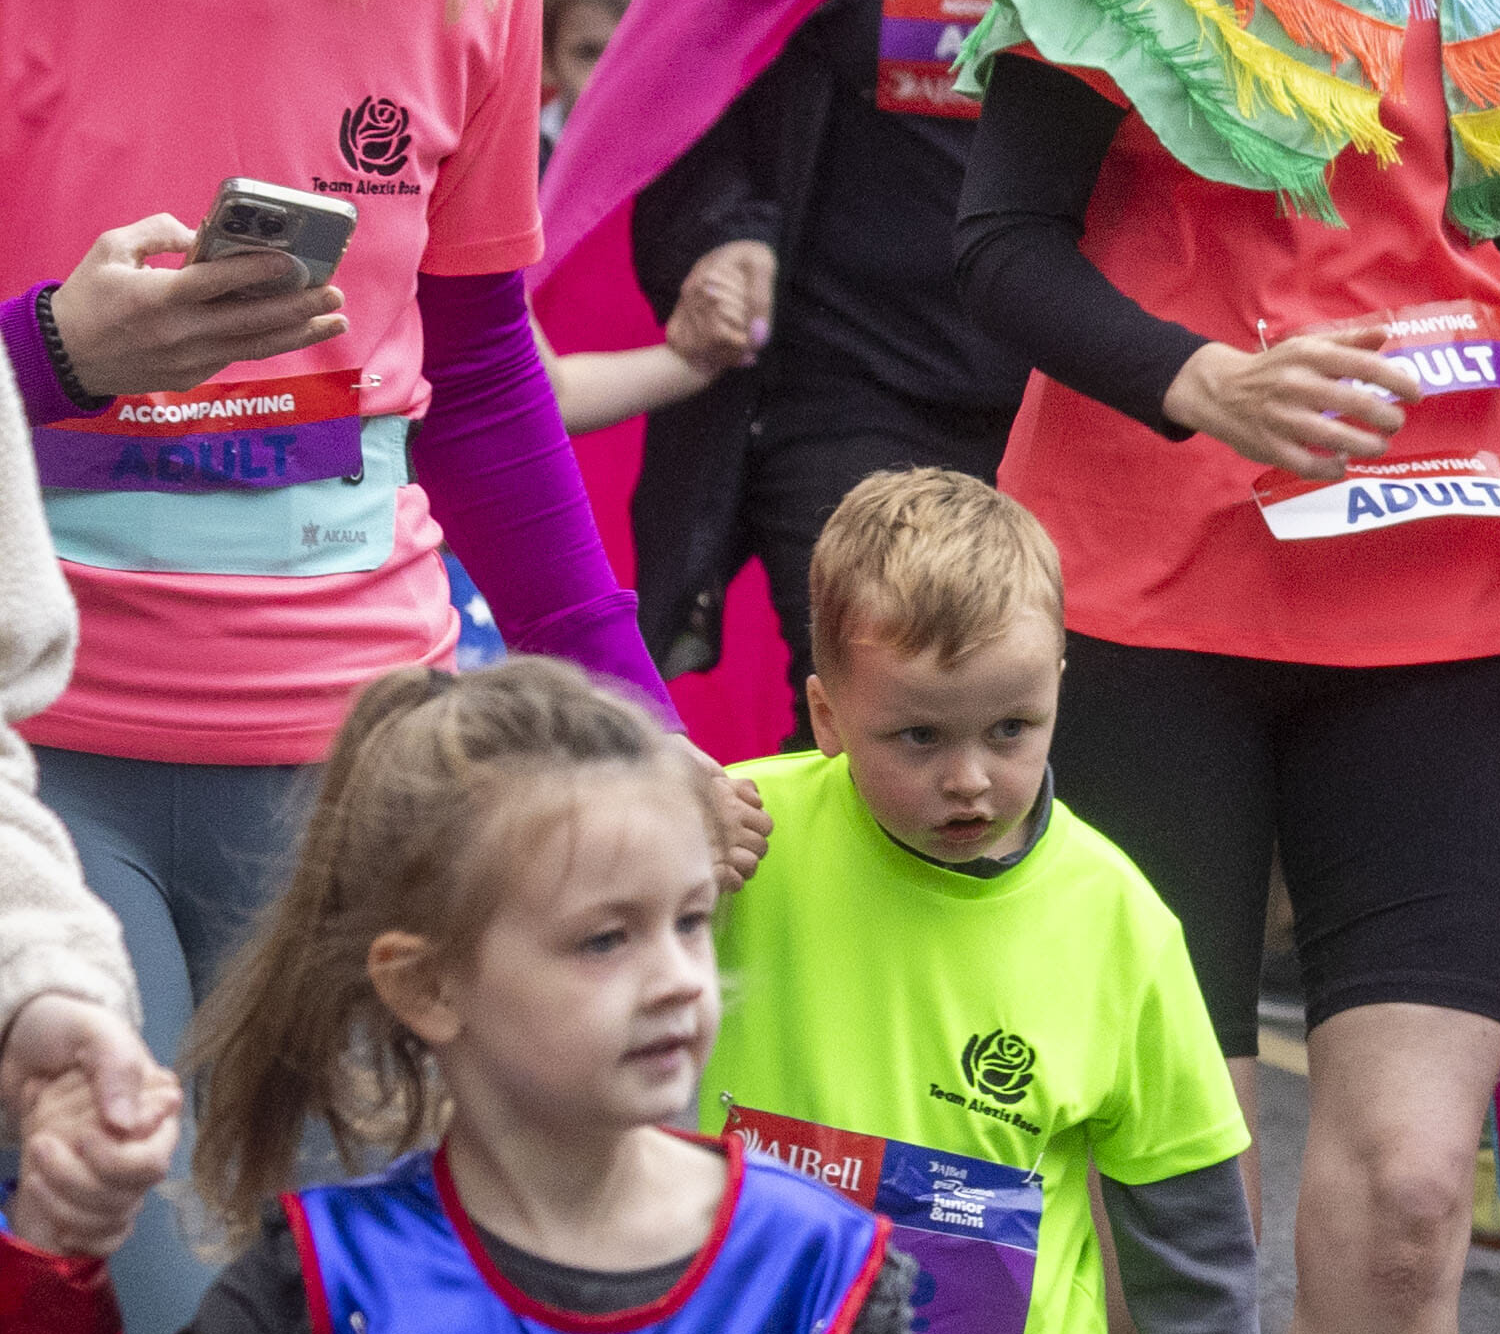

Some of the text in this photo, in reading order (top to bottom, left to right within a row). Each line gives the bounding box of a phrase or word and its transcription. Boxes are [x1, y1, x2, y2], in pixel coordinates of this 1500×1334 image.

[312, 177, 421, 195] Team Alexis Rose
[118, 394, 295, 423] ACCOMPANYING
[109, 434, 297, 482] ADULT
[929, 1082, 1042, 1136] Team Alexis Rose
